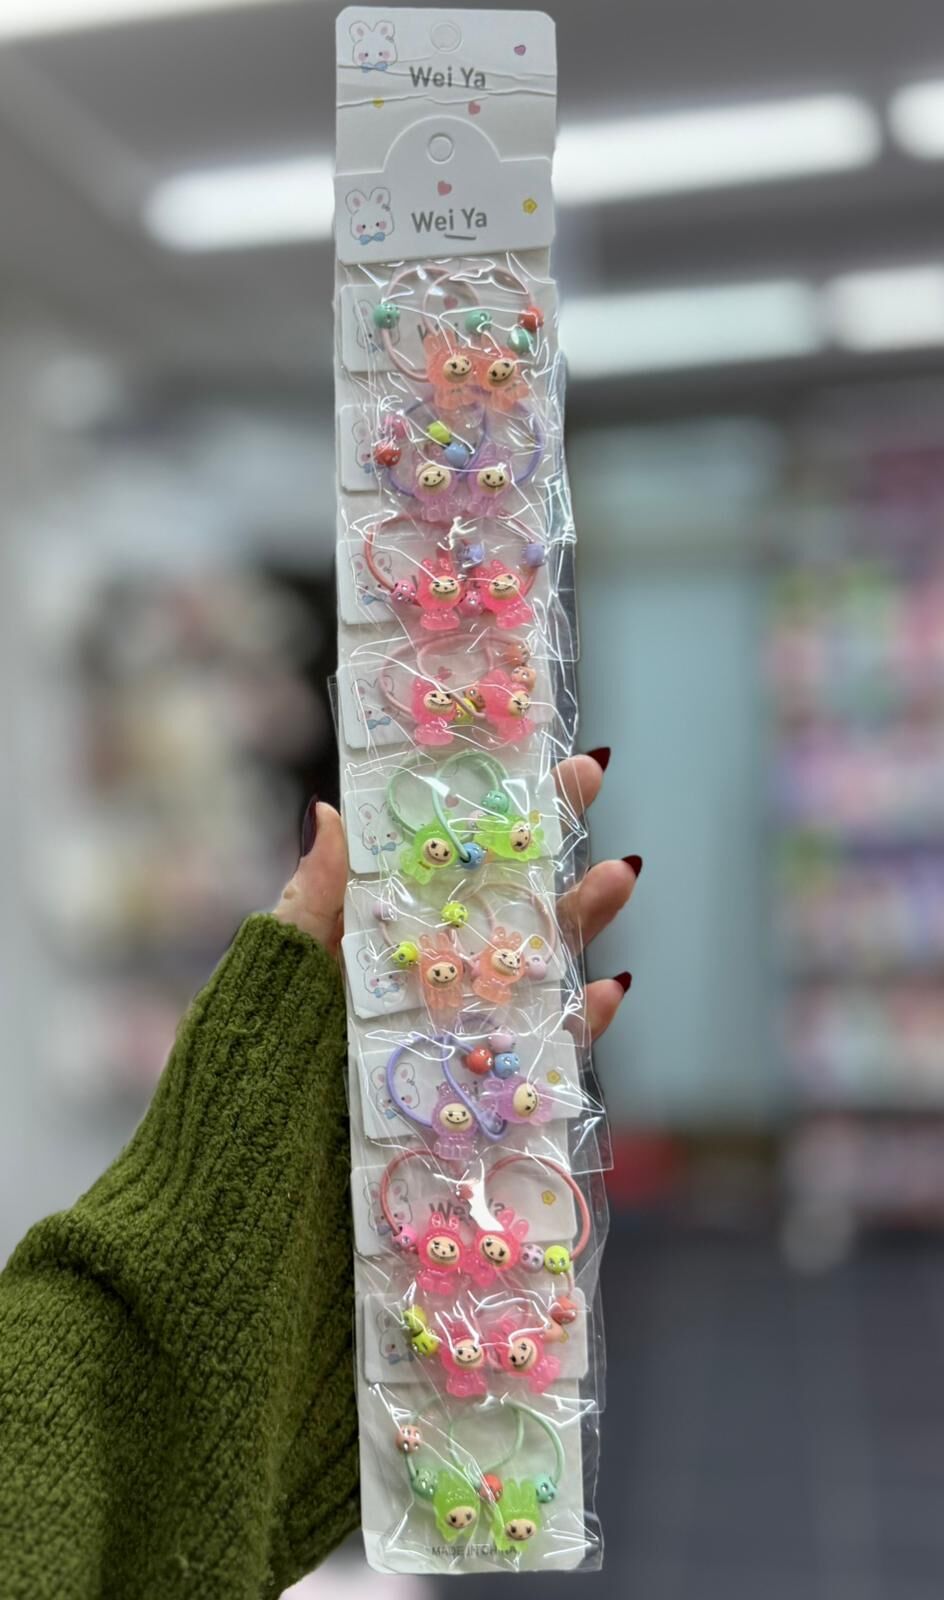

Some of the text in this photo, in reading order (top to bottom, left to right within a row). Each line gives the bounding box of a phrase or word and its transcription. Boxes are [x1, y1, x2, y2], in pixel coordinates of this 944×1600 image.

[409, 65, 486, 89] Wei Ya
[411, 207, 487, 234] Wei Ya
[431, 1544, 464, 1557] MADE
